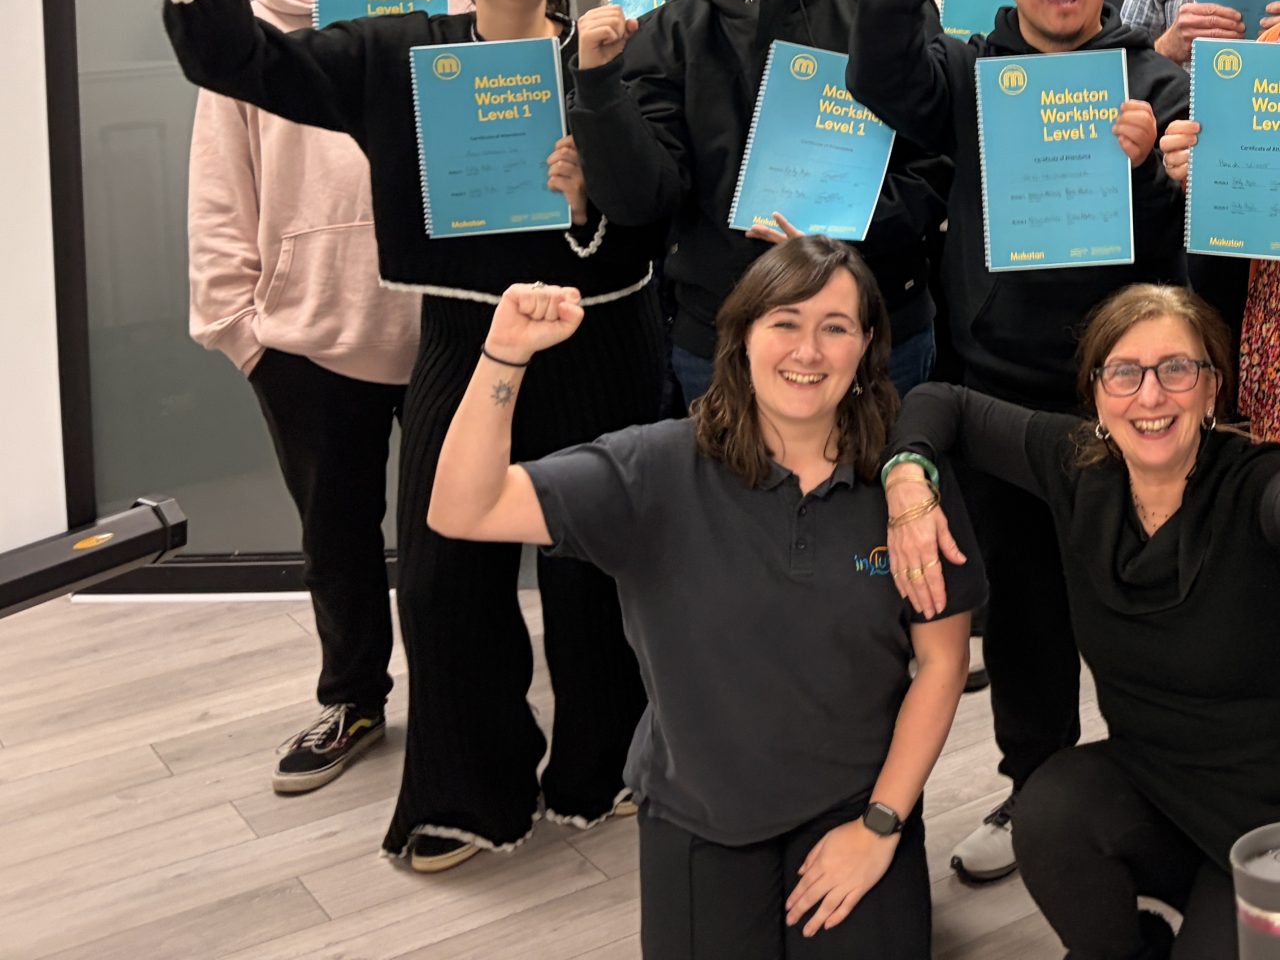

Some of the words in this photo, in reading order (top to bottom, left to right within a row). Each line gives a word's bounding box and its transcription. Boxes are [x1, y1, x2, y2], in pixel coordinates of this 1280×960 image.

[367, 4, 404, 17] Level
[474, 74, 540, 89] Makaton
[474, 86, 552, 108] Workshop
[1040, 88, 1108, 105] Makaton
[478, 104, 519, 122] Level
[522, 104, 532, 118] 1
[1041, 106, 1120, 124] Workshop
[815, 112, 854, 134] Level
[856, 122, 865, 136] 1
[1043, 122, 1084, 142] Level
[1088, 123, 1097, 139] 1
[1010, 252, 1045, 261] Makaton
